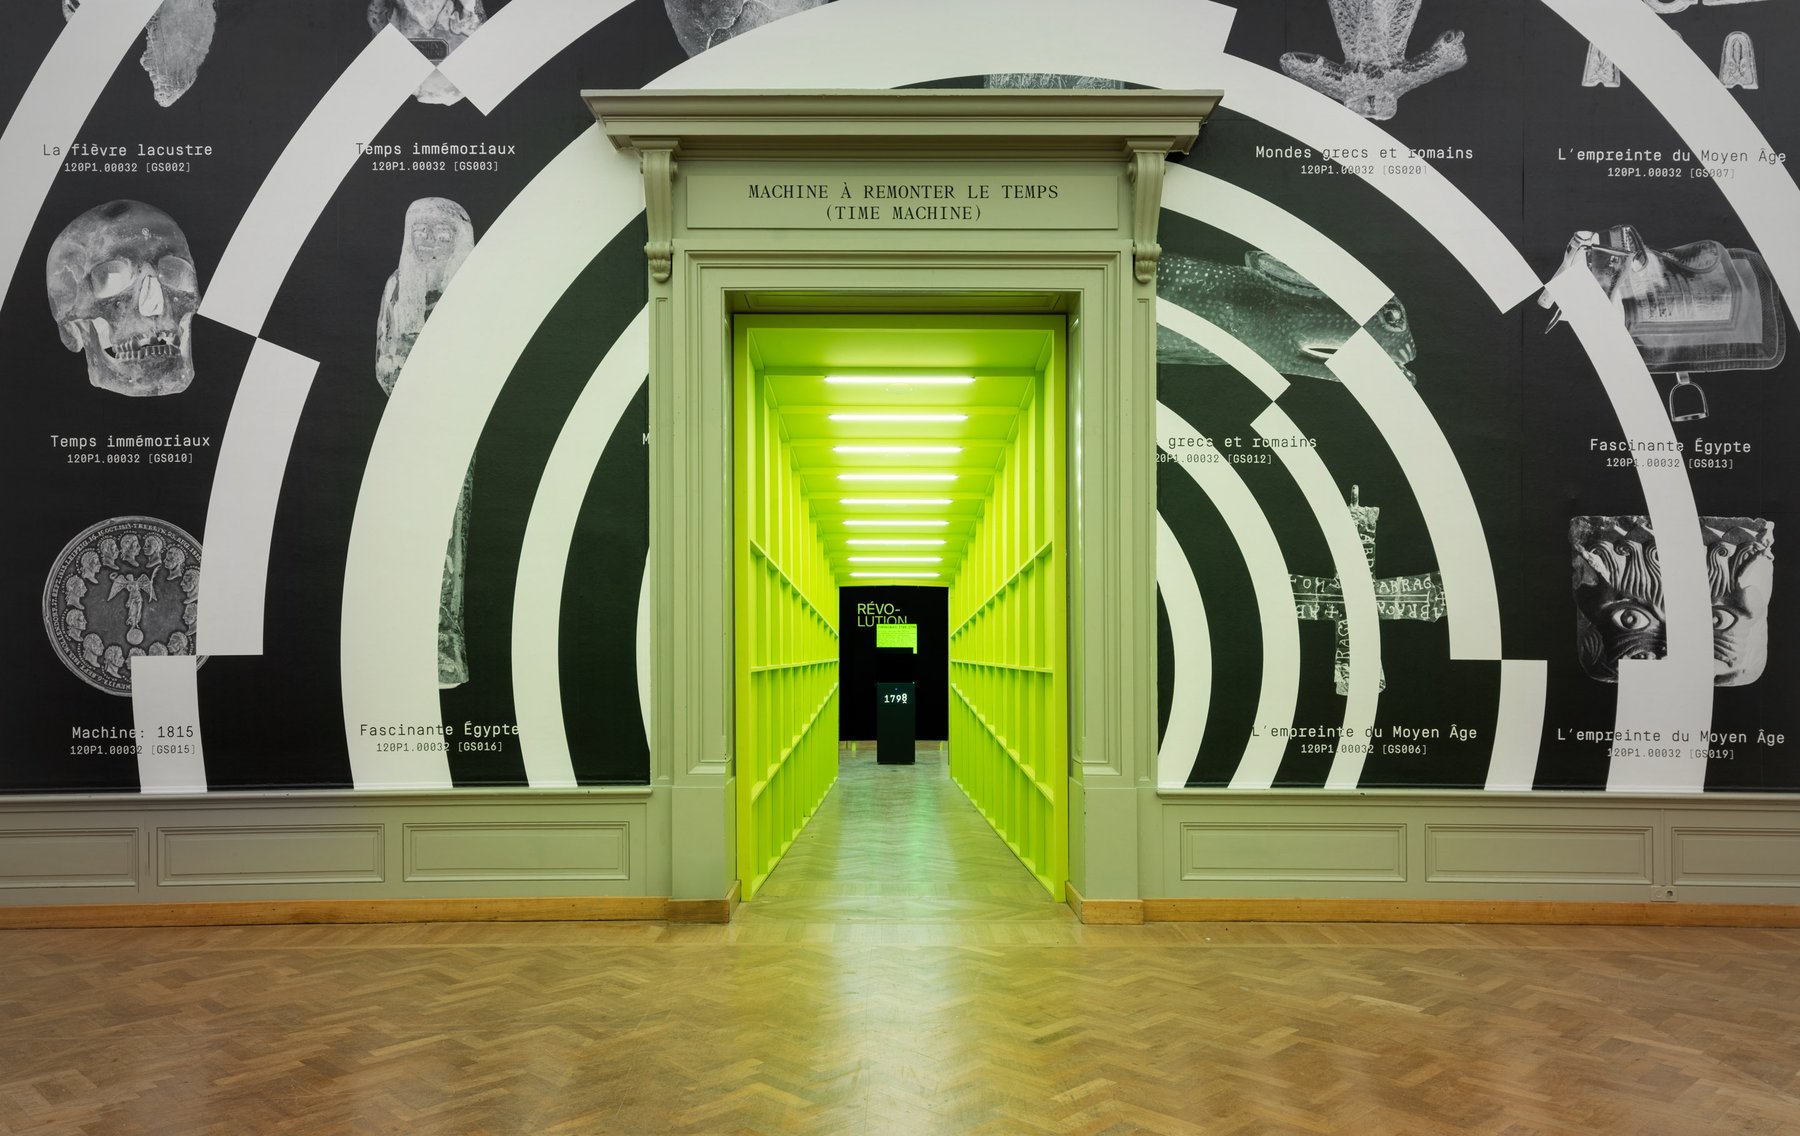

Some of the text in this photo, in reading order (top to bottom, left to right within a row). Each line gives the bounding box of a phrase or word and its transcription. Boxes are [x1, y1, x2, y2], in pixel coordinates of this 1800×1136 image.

[43, 144, 213, 156] La fièvre lacustre
[355, 142, 516, 157] Temps immémoriaux
[1255, 146, 1473, 161] Mondes grecs et romains
[1672, 149, 1690, 162] du
[1700, 150, 1748, 164] Moyen
[1758, 148, 1787, 165] Âge
[64, 162, 191, 173] 120P1.00032 [GS002]
[372, 161, 498, 171] 120P1.00032 [GS003]
[1300, 165, 1374, 175] 120P1.00032
[1607, 168, 1735, 179] 120P1.00032 [GS007]
[748, 182, 1058, 199] MACHINE À REMONTER LE TEMPS
[825, 205, 982, 221] (TIME MACHINE)
[50, 434, 210, 449] Temps immémoriaux
[1168, 436, 1317, 449] grecs et romains
[1590, 437, 1751, 455] Fascinante Égypte
[67, 453, 193, 464] 120P1.00032 [GS010]
[1228, 454, 1272, 465] [GS012]
[1606, 458, 1733, 469] 120P1.00032 [GS013]
[857, 600, 901, 615] RÉVO-
[857, 615, 907, 627] LUTION
[72, 726, 194, 739] Machine: 1815
[360, 721, 519, 738] Fascinante Égypte
[1365, 726, 1383, 738] du
[1392, 726, 1440, 741] Moyen
[1449, 724, 1477, 741] Âge
[1672, 730, 1689, 742] du
[1700, 730, 1747, 745] Moyen
[1757, 728, 1785, 746] Âge
[70, 744, 196, 755] 120P1.00032 [GS015]
[376, 742, 503, 752] 120P1.00032 [GS016]
[1382, 744, 1427, 755] [GS006]
[1607, 748, 1734, 760] 120P1.00032 [GS019]
